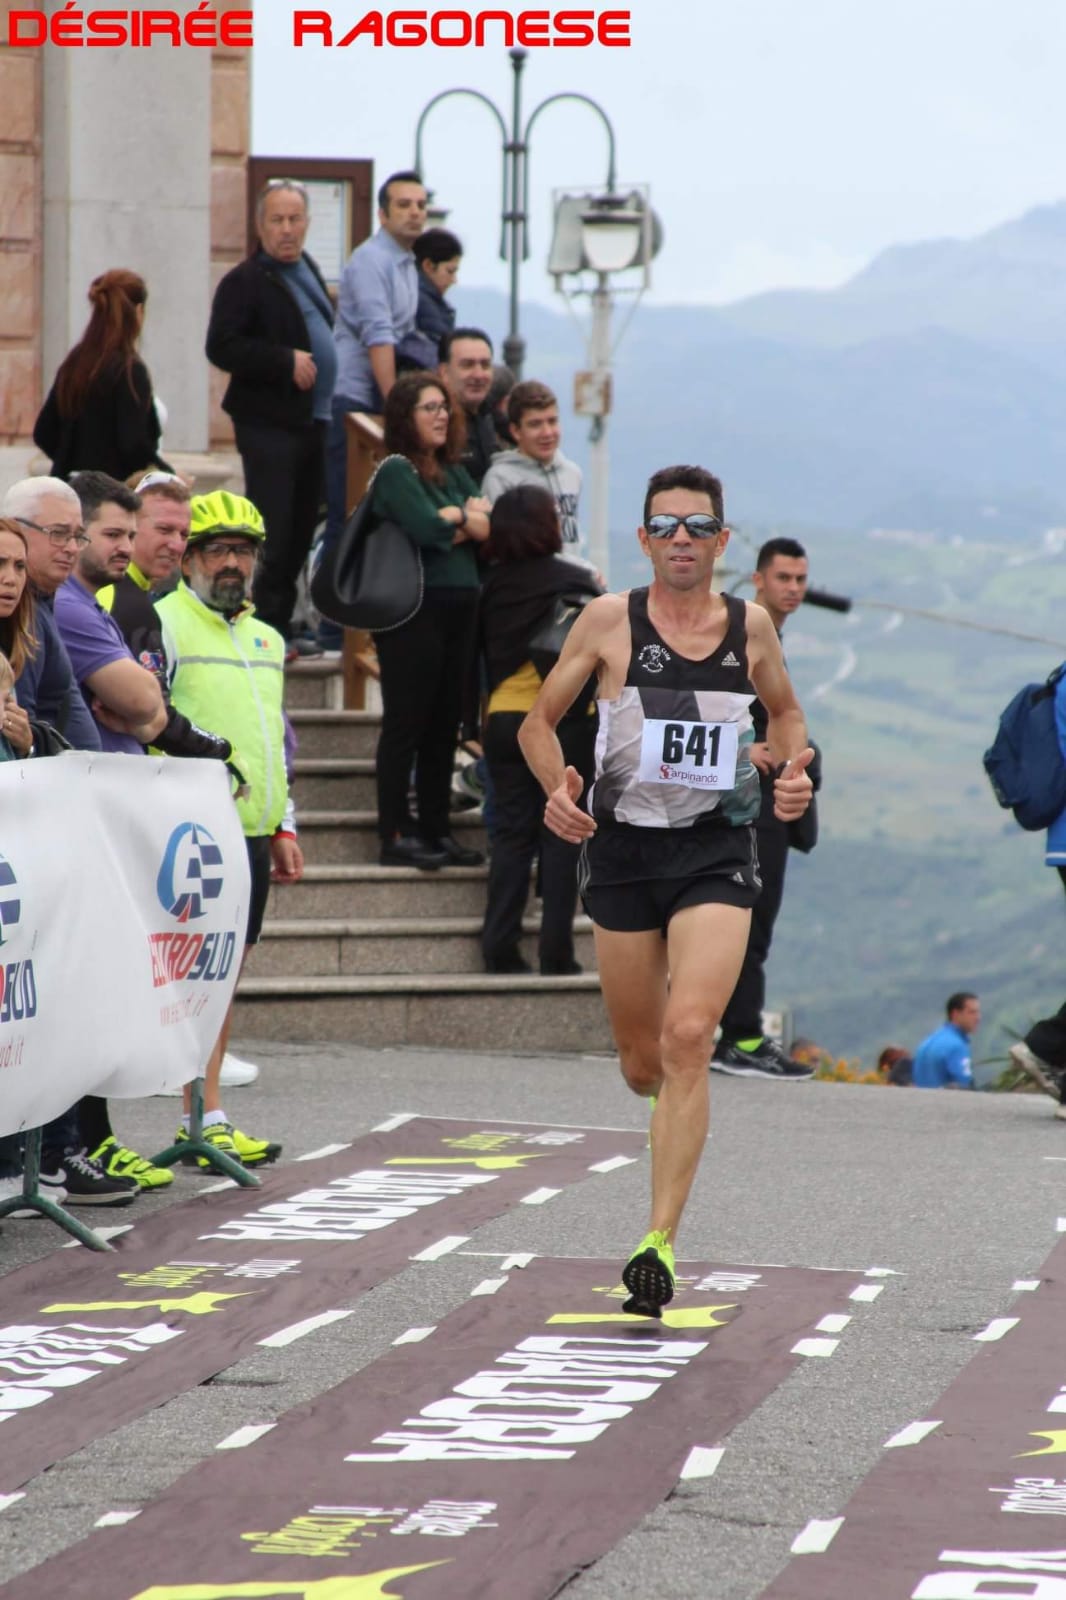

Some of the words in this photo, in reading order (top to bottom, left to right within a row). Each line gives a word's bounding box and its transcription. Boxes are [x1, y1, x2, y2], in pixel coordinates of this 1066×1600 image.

[662, 723, 721, 767] 641
[0, 959, 37, 1023] SUD
[197, 1169, 499, 1241] DIADORA
[343, 1335, 709, 1463] DIADORA
[390, 1500, 499, 1537] make
